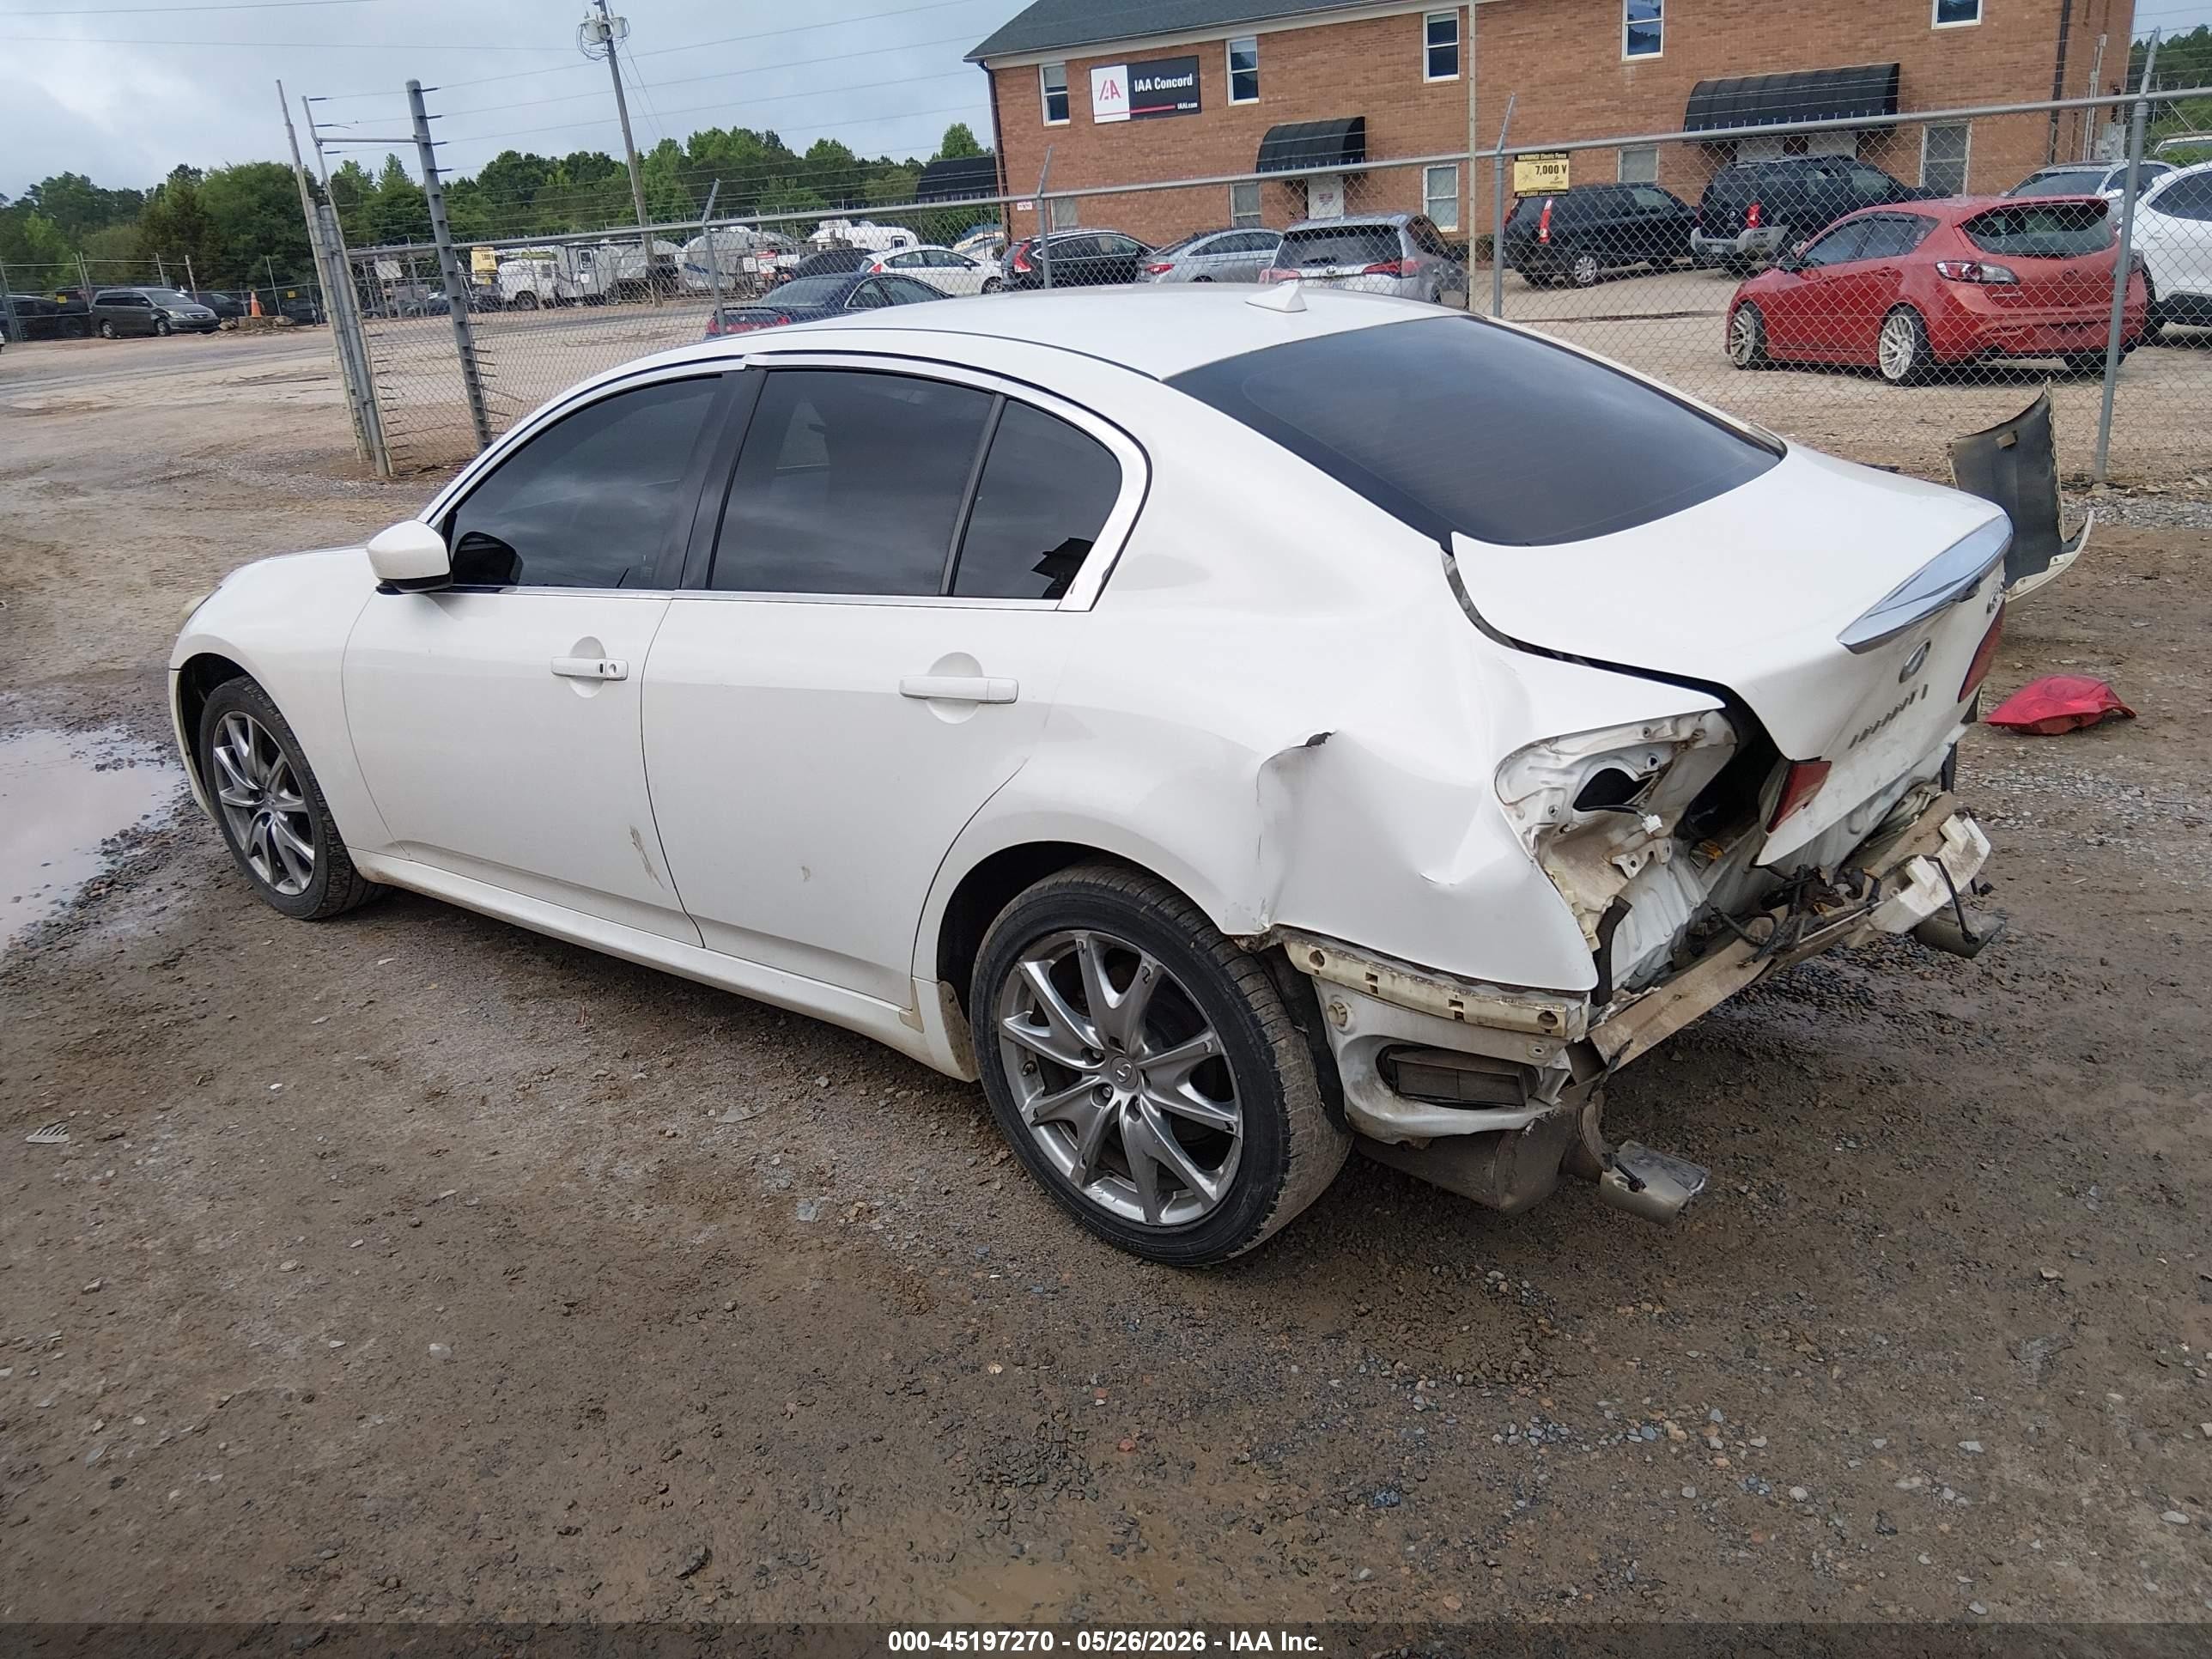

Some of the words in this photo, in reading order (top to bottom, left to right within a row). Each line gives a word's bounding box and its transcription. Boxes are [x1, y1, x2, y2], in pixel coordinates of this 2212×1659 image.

[1134, 80, 1152, 92] IAA
[1154, 73, 1193, 89] Concord
[1535, 164, 1559, 176] 7,000
[1561, 164, 1567, 174] V
